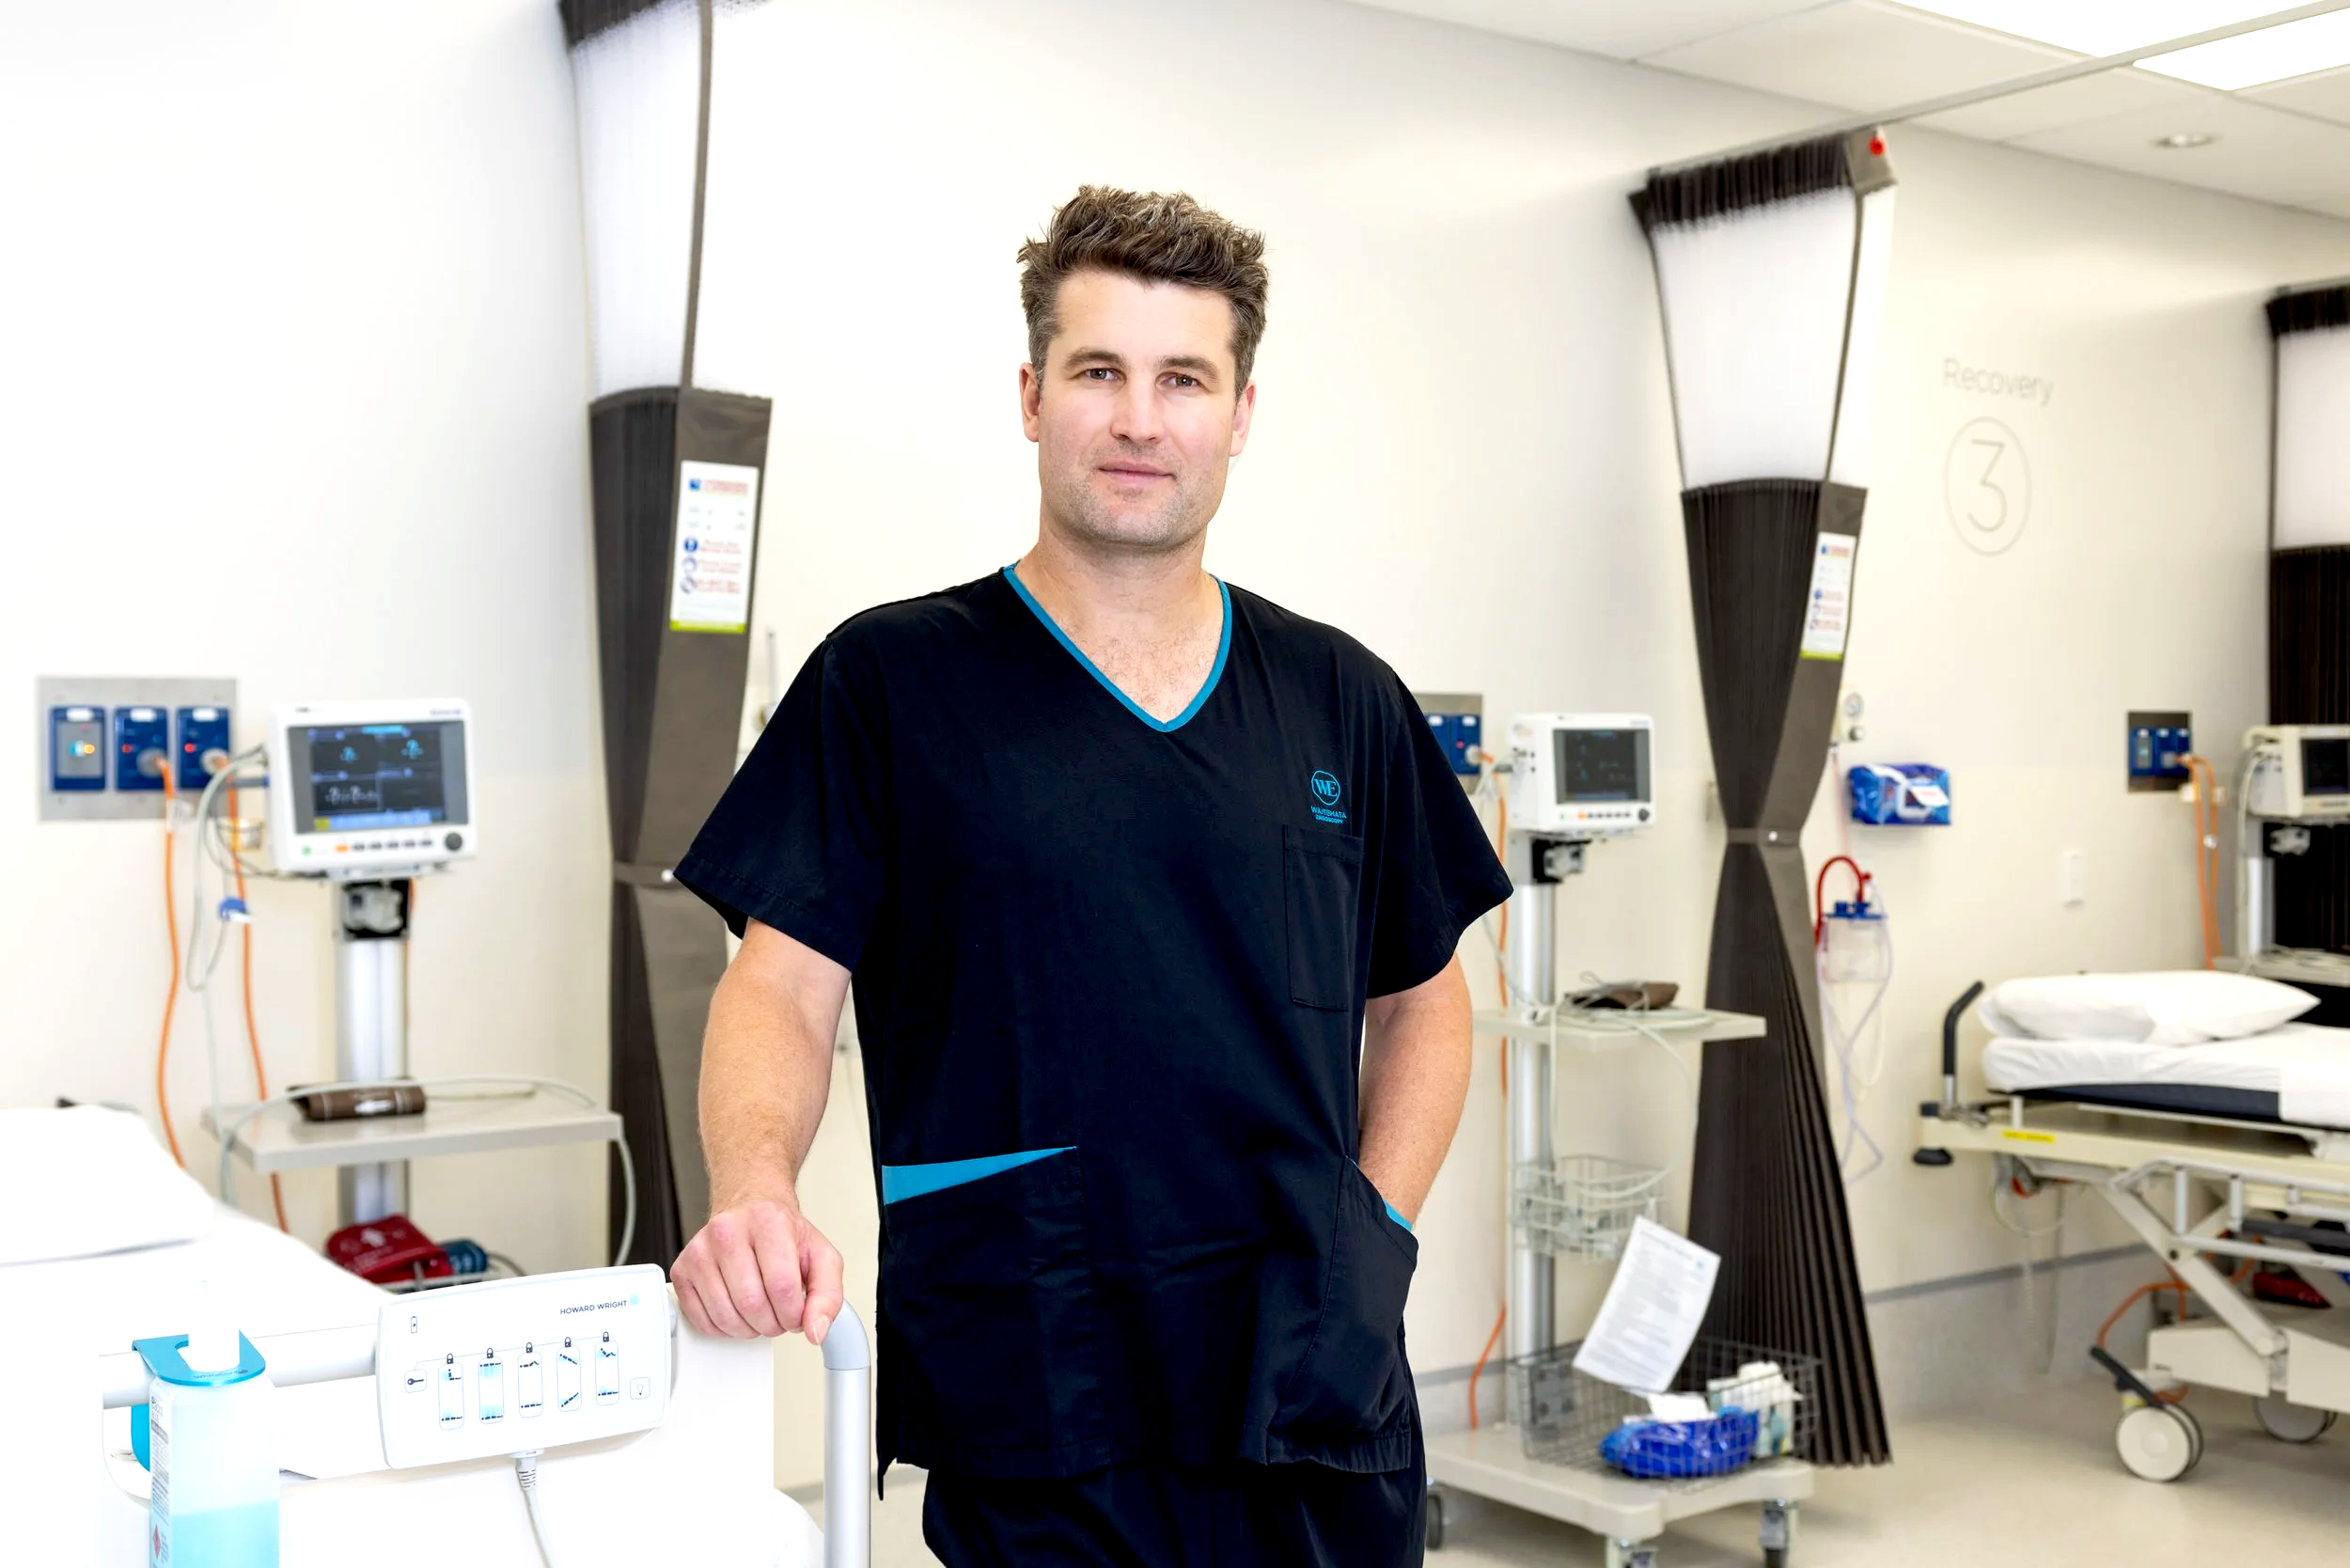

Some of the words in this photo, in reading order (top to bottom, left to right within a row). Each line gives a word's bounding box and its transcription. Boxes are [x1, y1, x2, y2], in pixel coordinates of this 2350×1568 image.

[1943, 357, 2054, 407] Recovery
[1966, 438, 2008, 534] 3
[1314, 779, 1337, 796] WE
[559, 1304, 595, 1315] HOWARD
[597, 1299, 628, 1310] WRIGHT
